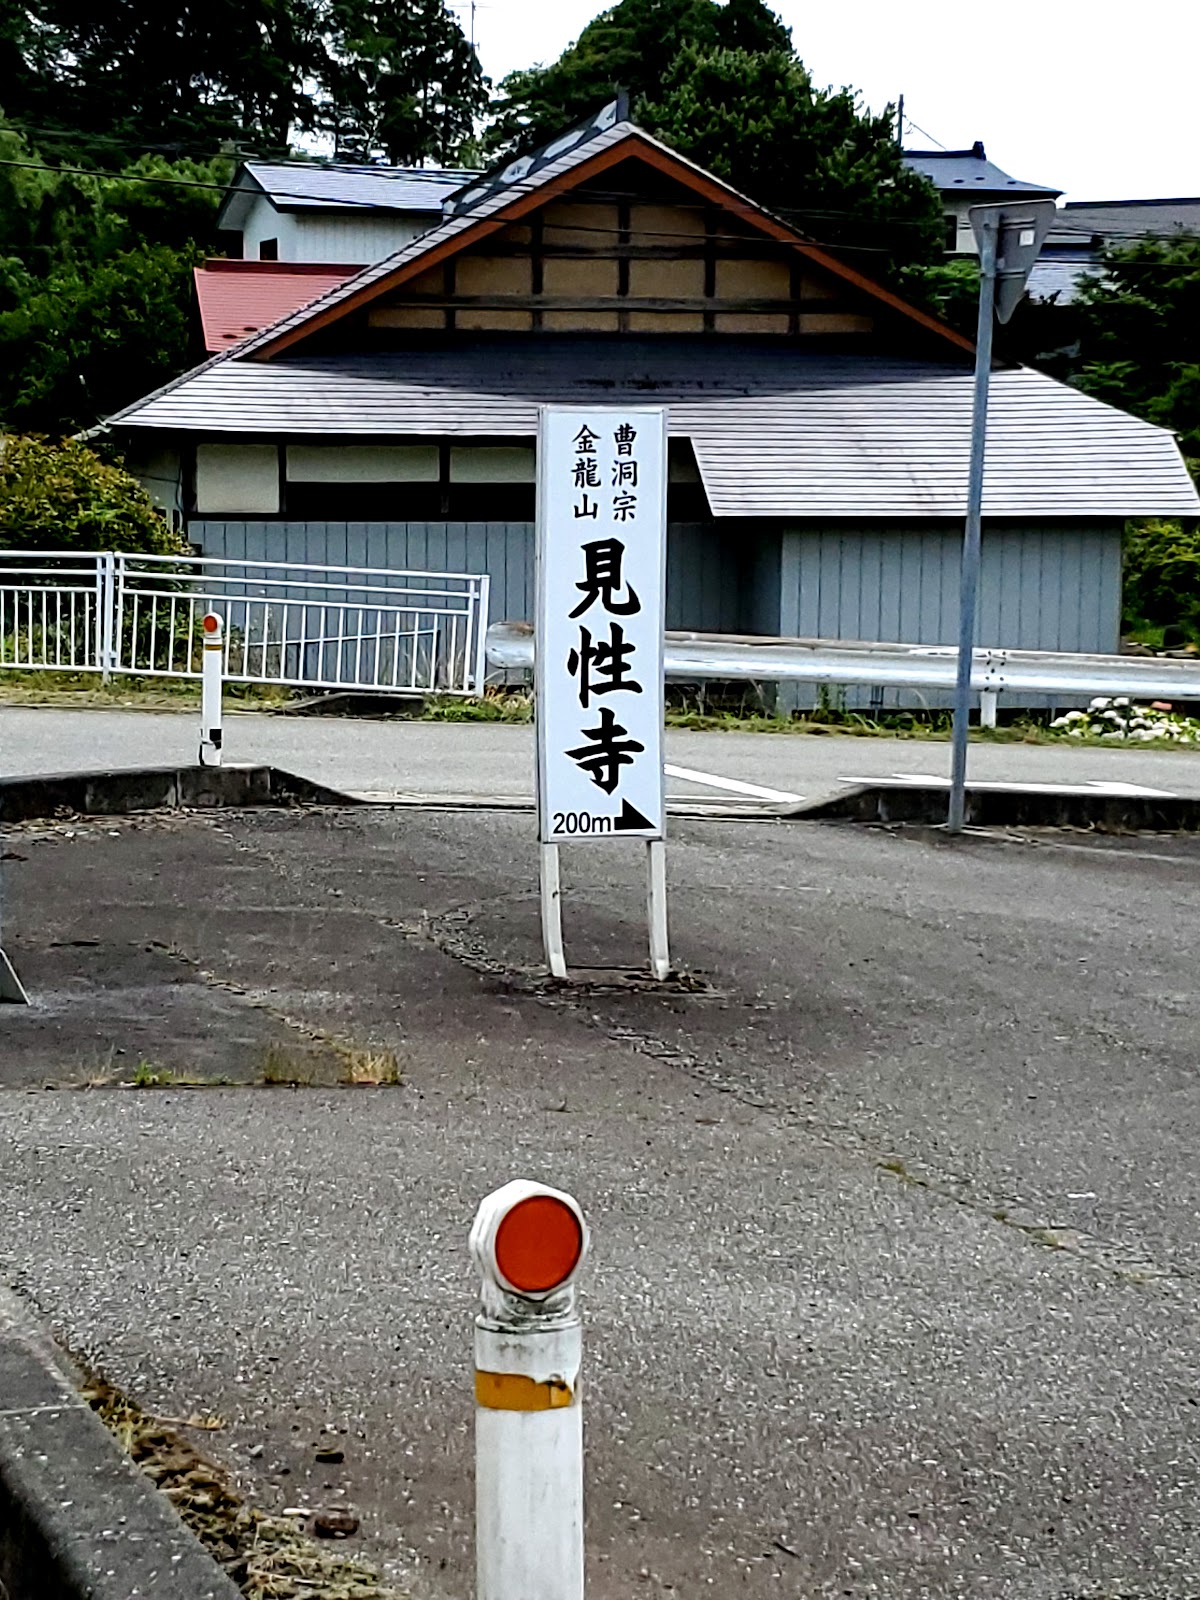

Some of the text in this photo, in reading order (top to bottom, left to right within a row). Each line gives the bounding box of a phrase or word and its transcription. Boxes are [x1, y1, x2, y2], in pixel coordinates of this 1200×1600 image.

[571, 424, 602, 519] 金龍山
[612, 423, 638, 522] 曹洞宗
[564, 537, 645, 796] 見性寺
[553, 812, 611, 834] 200m
